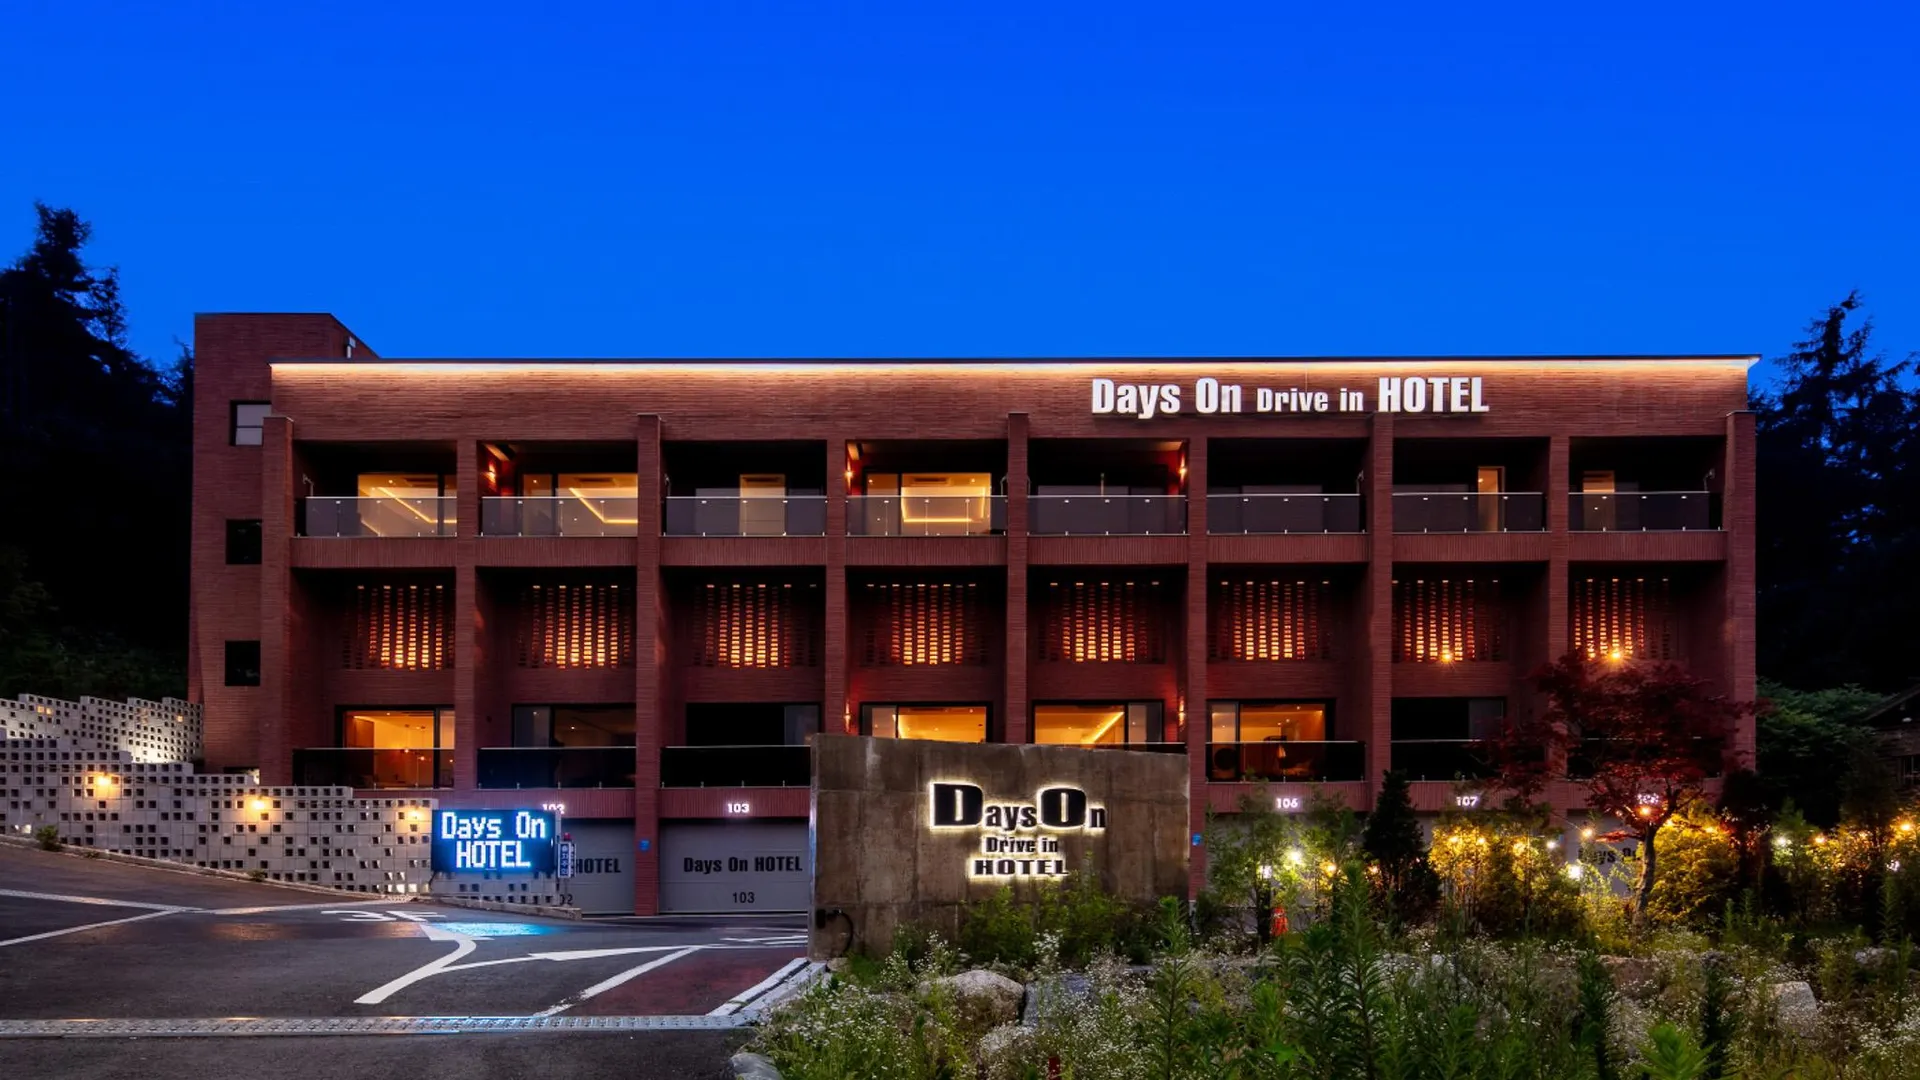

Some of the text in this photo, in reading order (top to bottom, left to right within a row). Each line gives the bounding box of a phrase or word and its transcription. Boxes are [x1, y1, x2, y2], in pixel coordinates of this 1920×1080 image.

[1091, 376, 1490, 420] Days On Drive in HOTEL
[727, 803, 750, 813] 103
[1276, 797, 1298, 809] 106
[1456, 796, 1478, 807] 107
[440, 812, 546, 841] Days On
[985, 837, 1059, 853] Drive in
[455, 841, 532, 868] HOTEL
[575, 858, 622, 873] HOTEL
[683, 855, 803, 875] Days On HOTEL
[974, 859, 1069, 875] HOTEL
[732, 892, 755, 904] 103
